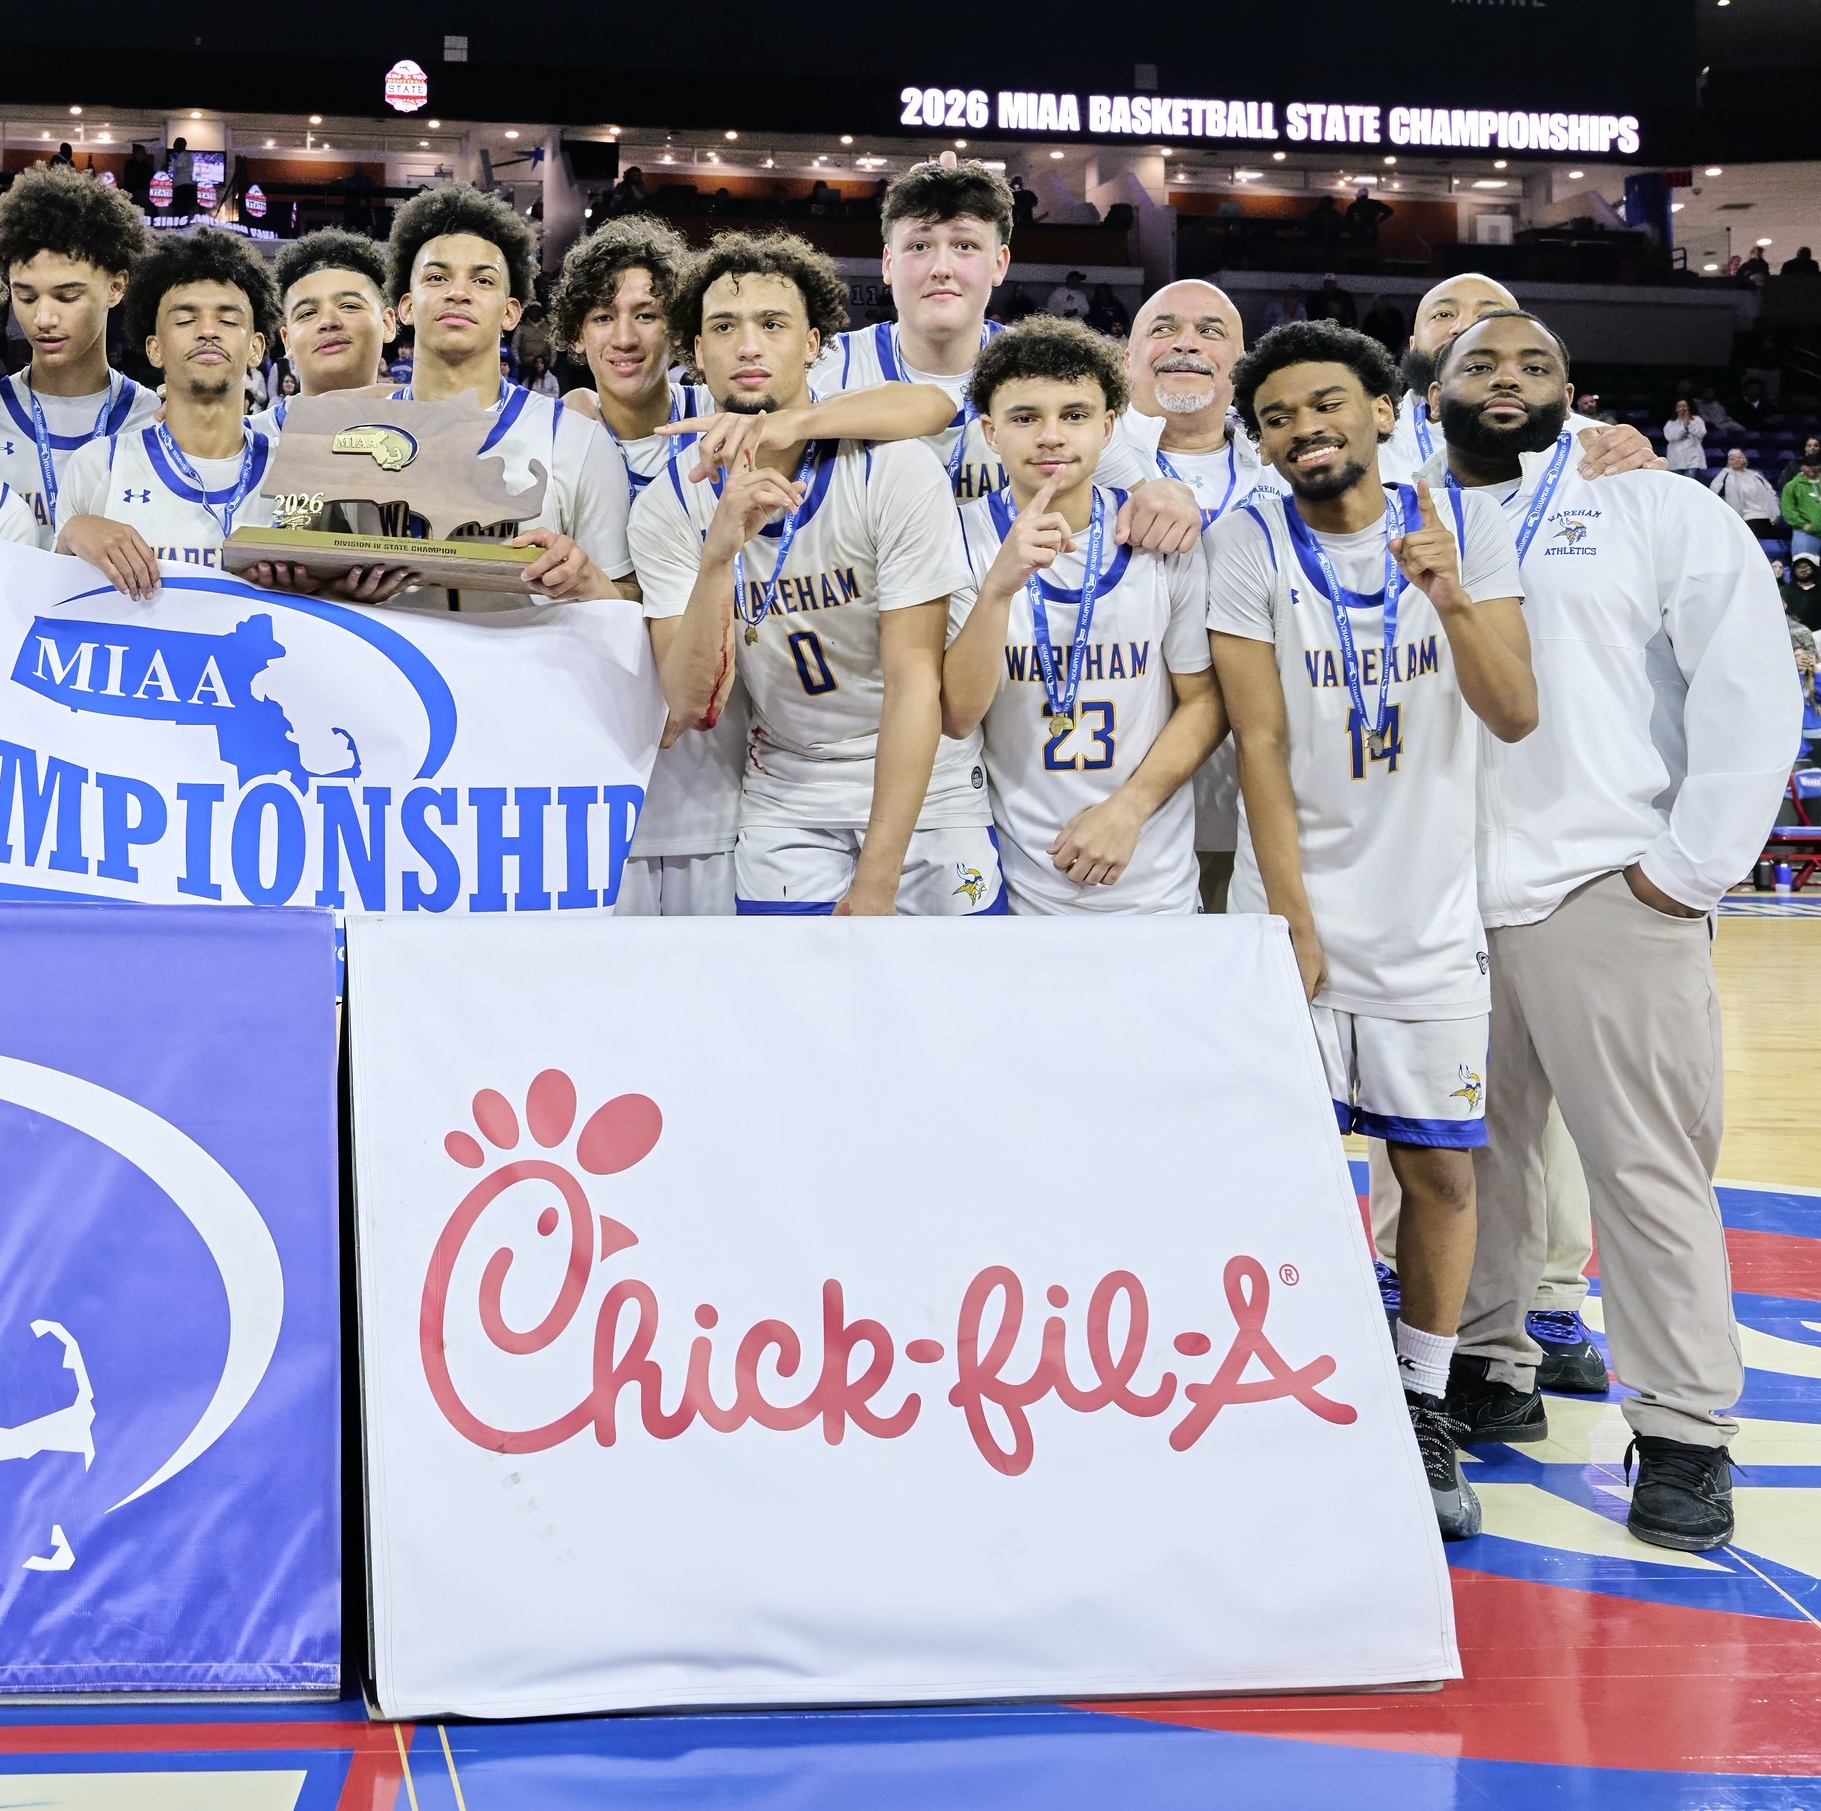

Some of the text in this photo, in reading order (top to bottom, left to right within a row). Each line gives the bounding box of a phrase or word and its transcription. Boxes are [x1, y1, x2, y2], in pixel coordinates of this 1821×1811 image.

[900, 87, 1640, 153] 2026 MIAA BASKETBALL STATE CHAMPIONSHIPS
[336, 436, 378, 449] MIAA
[273, 492, 325, 515] 2026
[1534, 486, 1551, 512] CHAMPION
[1548, 509, 1603, 522] WAREHAM
[334, 539, 371, 549] DIVISION
[384, 543, 409, 552] STATE
[411, 546, 457, 555] CHAMPION
[1090, 539, 1100, 571] CHAMPION
[1544, 547, 1597, 556] ATHLETICS
[1081, 592, 1093, 626] CHAMPION
[1341, 626, 1352, 659] CHAMPION
[31, 633, 236, 708] MIAA
[788, 629, 839, 696] 0
[1005, 640, 1151, 682] WARHAM
[1071, 645, 1082, 681] CHAMPION
[1041, 699, 1118, 772] 23
[1345, 702, 1404, 781] 14
[420, 1159, 1358, 1477] Chick-fil-A
